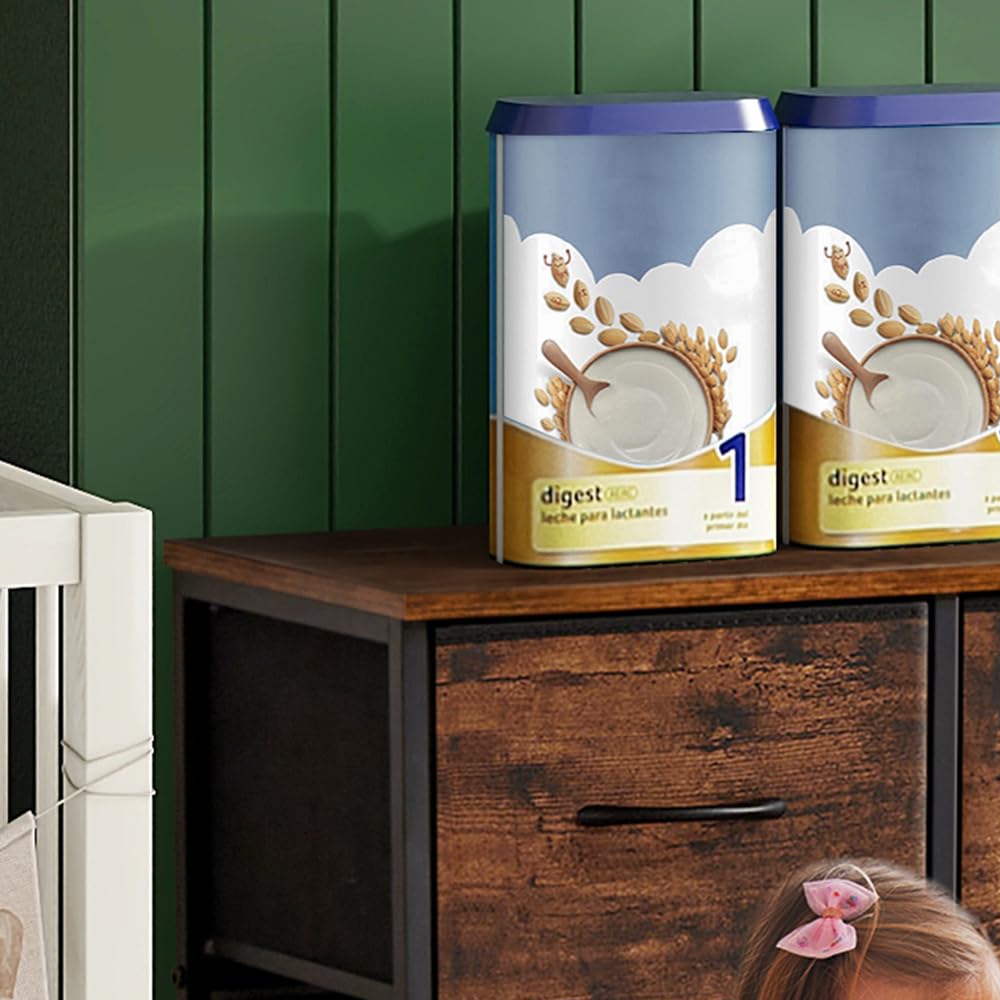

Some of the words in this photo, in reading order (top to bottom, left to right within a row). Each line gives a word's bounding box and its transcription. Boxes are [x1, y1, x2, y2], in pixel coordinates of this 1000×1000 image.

[719, 432, 746, 502] 1
[827, 468, 887, 492] digest
[540, 484, 602, 509] digest
[828, 493, 864, 506] leche
[866, 494, 893, 507] para
[896, 488, 951, 502] lactantes
[541, 511, 577, 524] leche
[580, 511, 608, 525] para
[611, 506, 669, 520] lactantes
